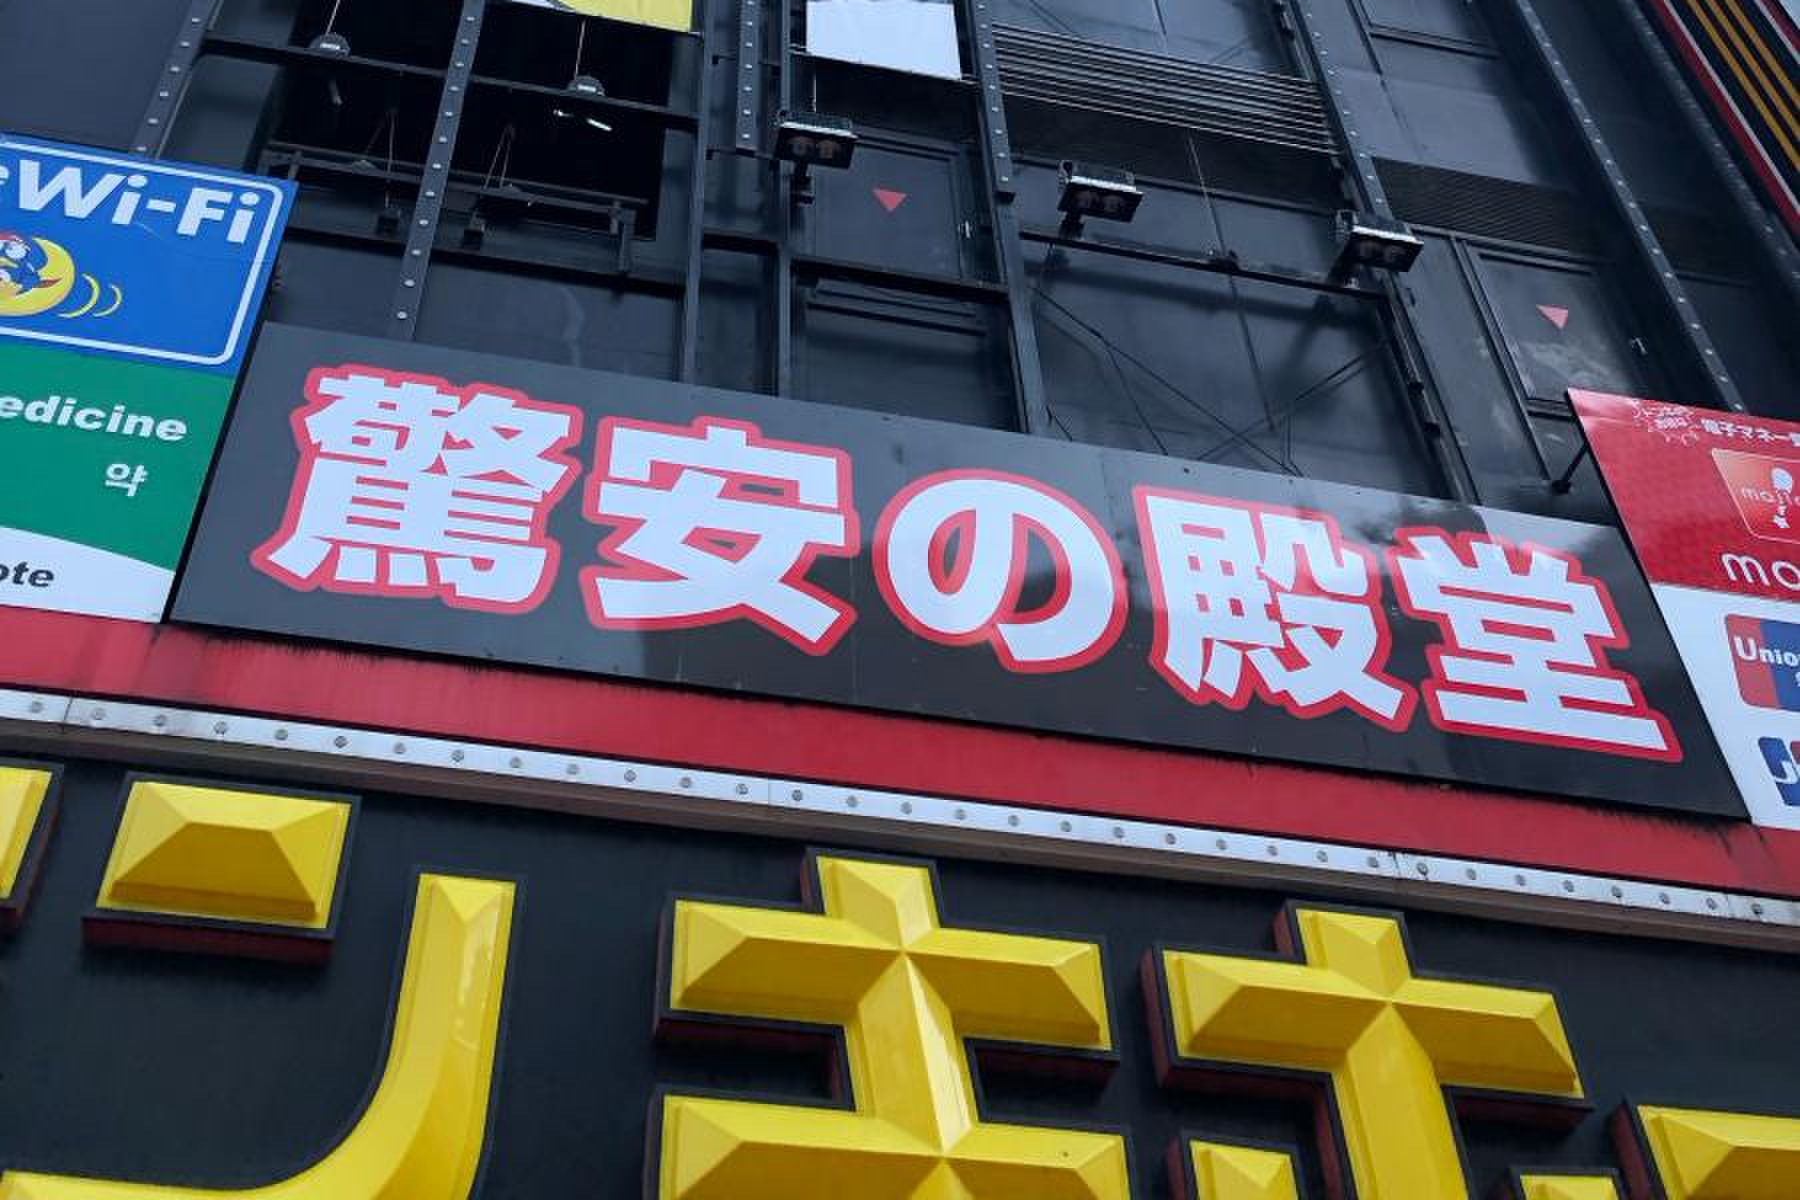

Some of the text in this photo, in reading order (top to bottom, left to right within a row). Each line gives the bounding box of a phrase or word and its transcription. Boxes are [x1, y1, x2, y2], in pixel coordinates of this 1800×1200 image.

[105, 462, 148, 497] 약
[250, 364, 1684, 762] 驚安の殿堂
[1733, 636, 1800, 667] Unio
